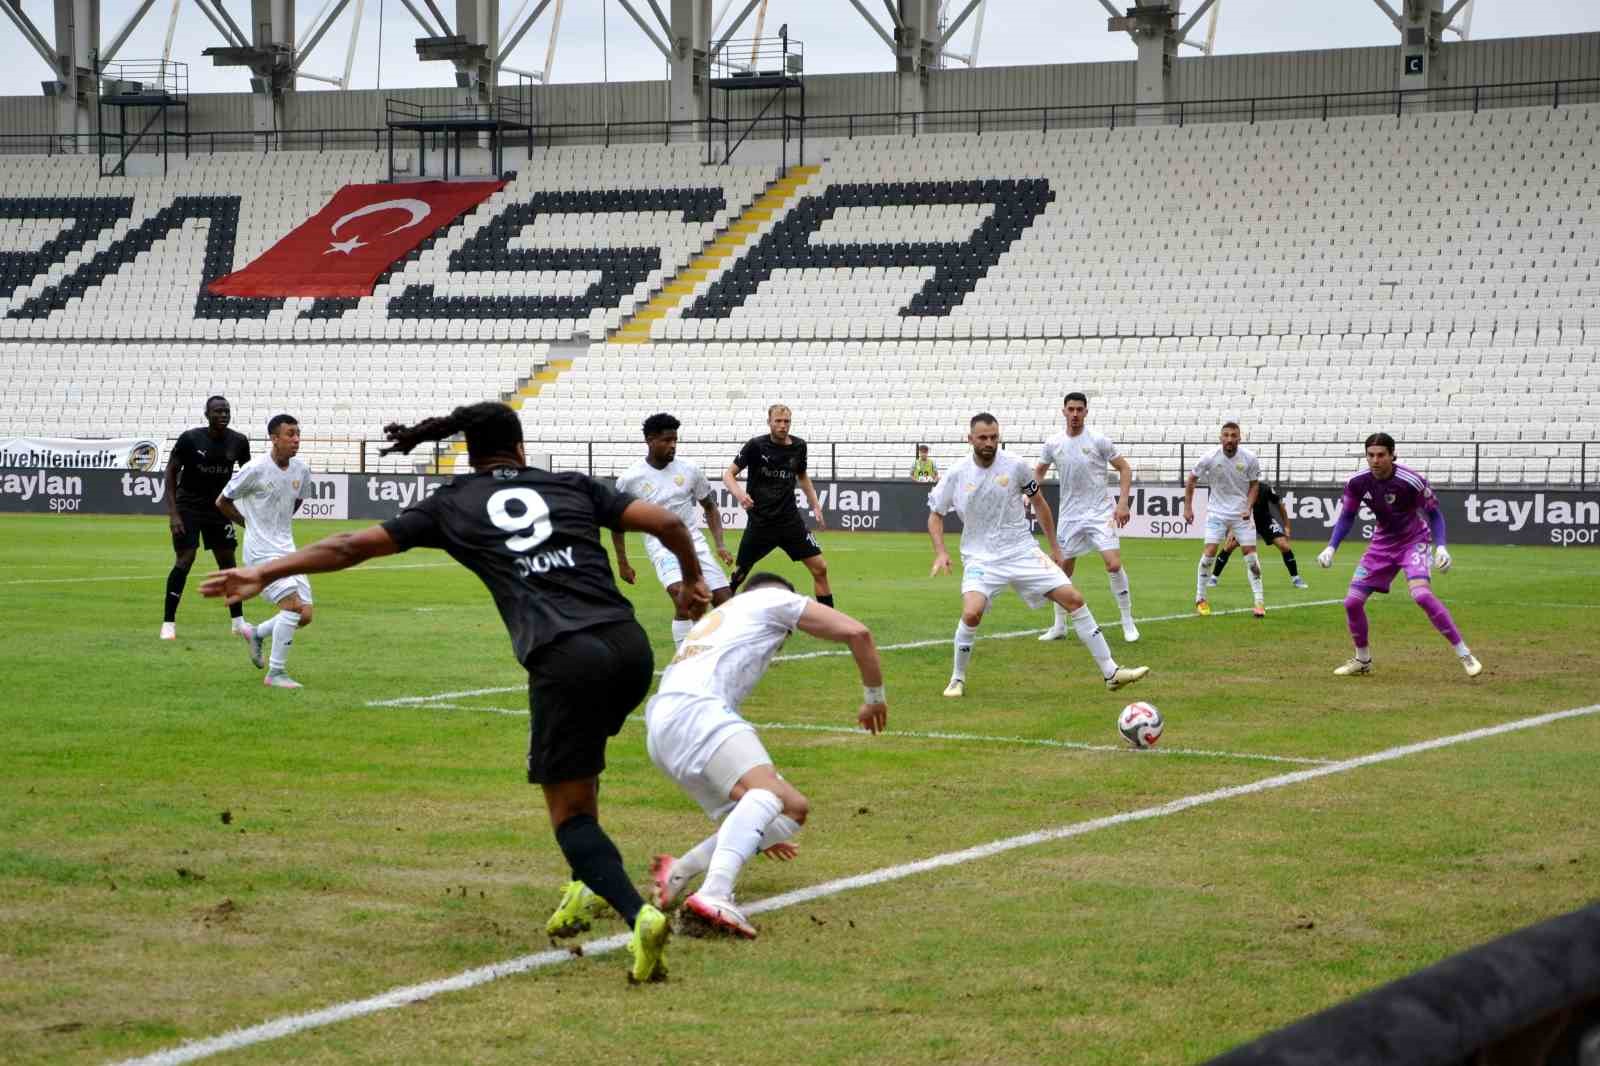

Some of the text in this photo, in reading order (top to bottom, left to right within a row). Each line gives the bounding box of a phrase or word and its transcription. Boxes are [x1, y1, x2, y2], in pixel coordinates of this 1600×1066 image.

[1410, 59, 1419, 70] C
[0, 449, 118, 468] iyebilenindir.
[0, 469, 82, 500] aylan
[49, 497, 81, 513] spor
[302, 503, 335, 518] spor
[1465, 493, 1600, 531] taylan
[487, 487, 552, 552] 9
[703, 512, 738, 525] sor
[842, 514, 880, 531] spor
[1551, 528, 1599, 547] spor
